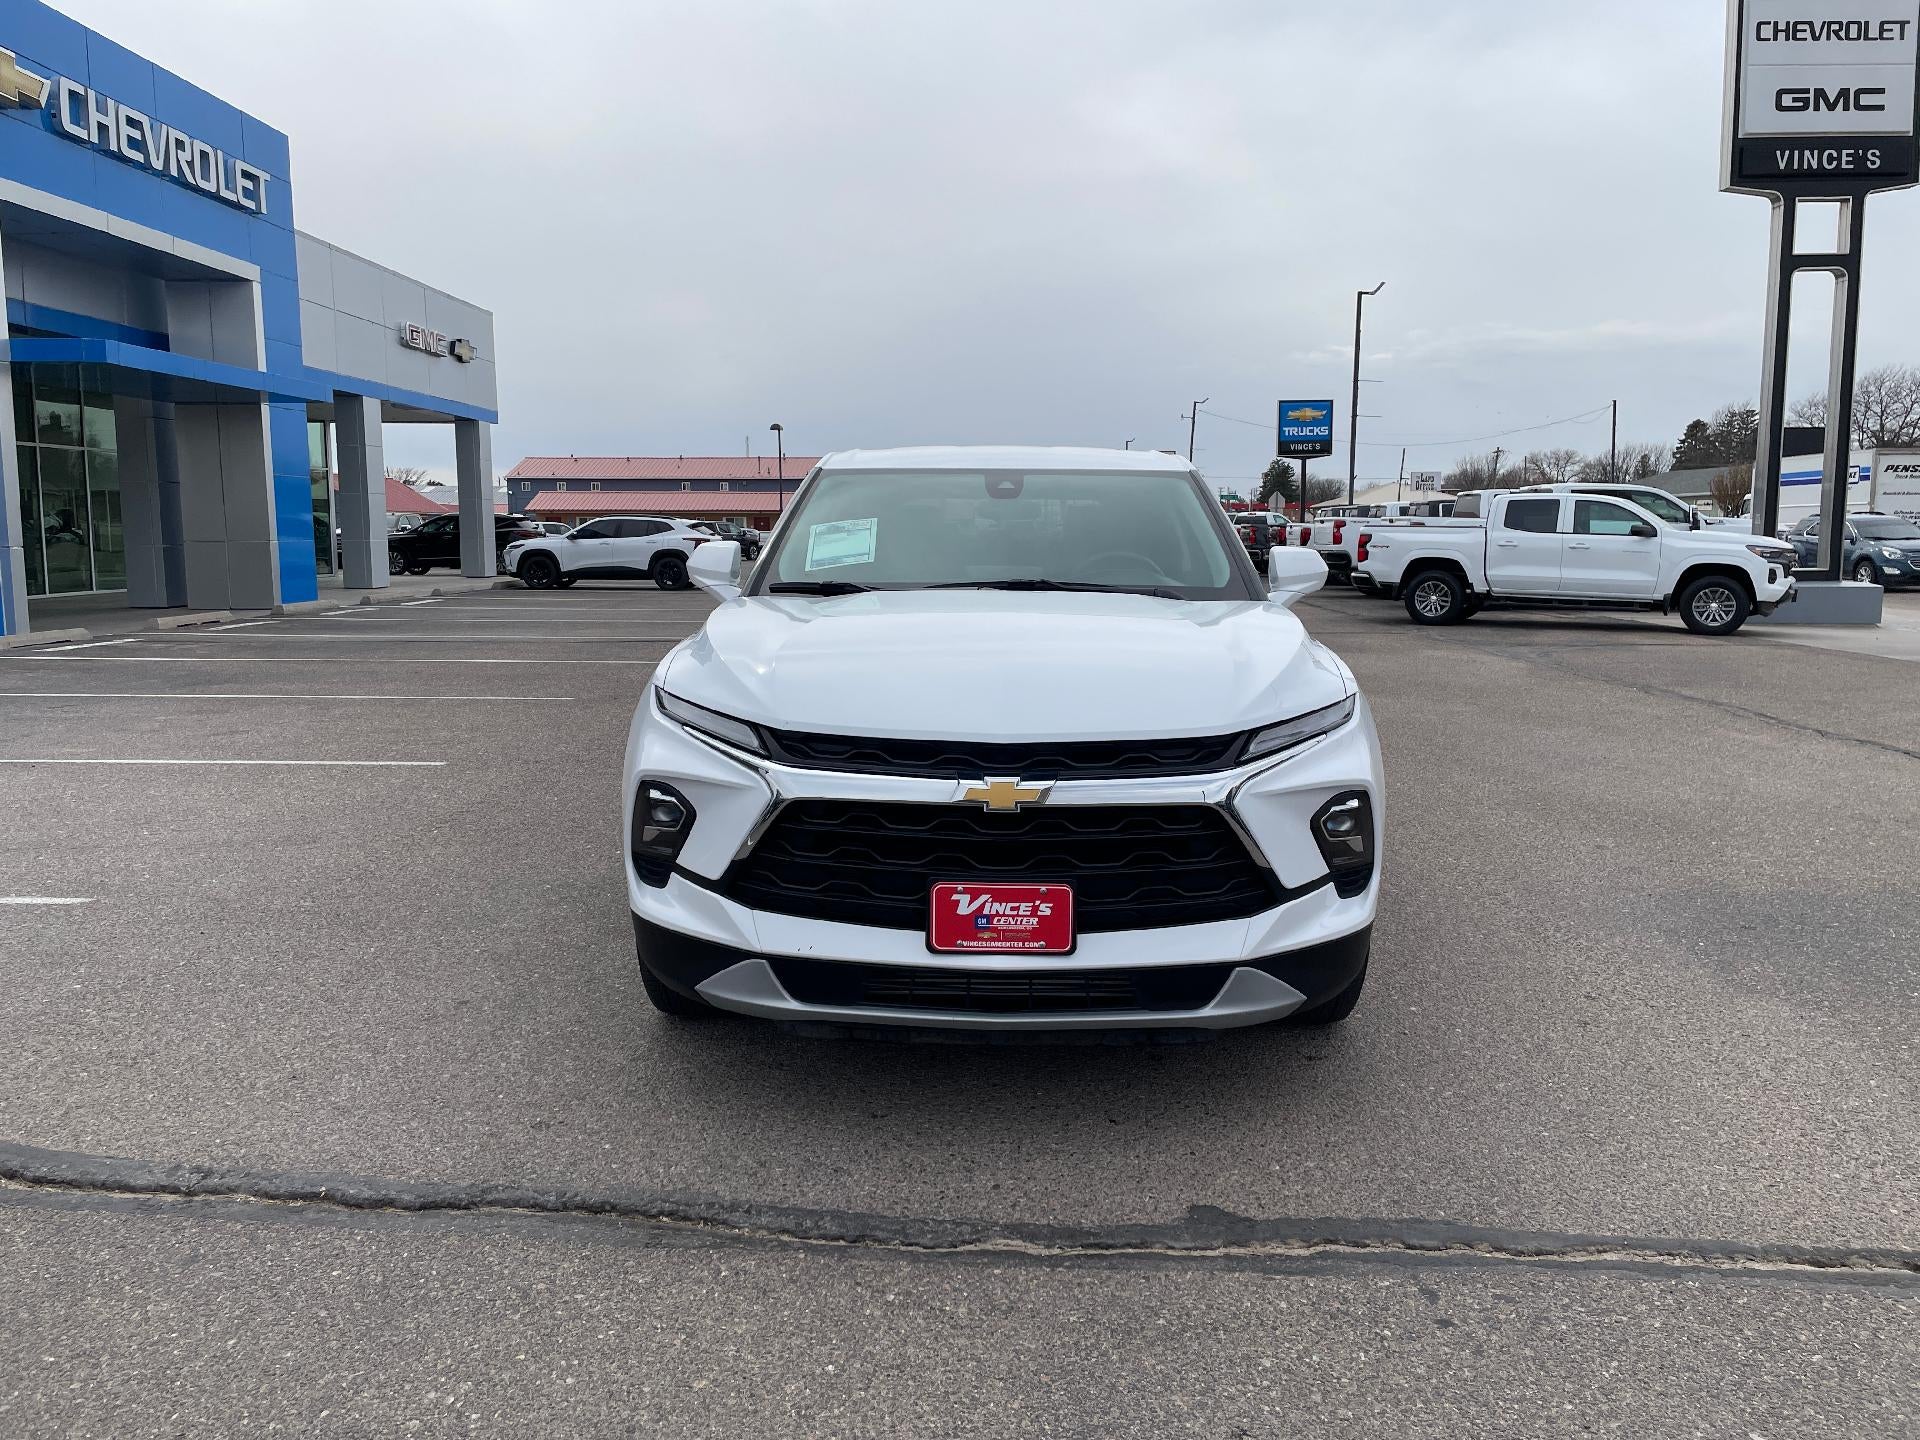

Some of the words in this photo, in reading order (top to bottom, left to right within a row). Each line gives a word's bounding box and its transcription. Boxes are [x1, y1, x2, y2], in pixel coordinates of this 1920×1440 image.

[1755, 20, 1911, 42] CHEVROLET
[1774, 87, 1886, 112] GMC
[58, 76, 271, 215] CHEVROLET
[1775, 149, 1881, 170] VINCE'S
[405, 321, 448, 357] GMC
[1282, 426, 1329, 436] TRUCKS
[1290, 443, 1321, 451] VINCE'S
[1883, 464, 1920, 473] PENS
[951, 894, 1053, 915] VINCE'S
[993, 916, 1039, 925] CENTER
